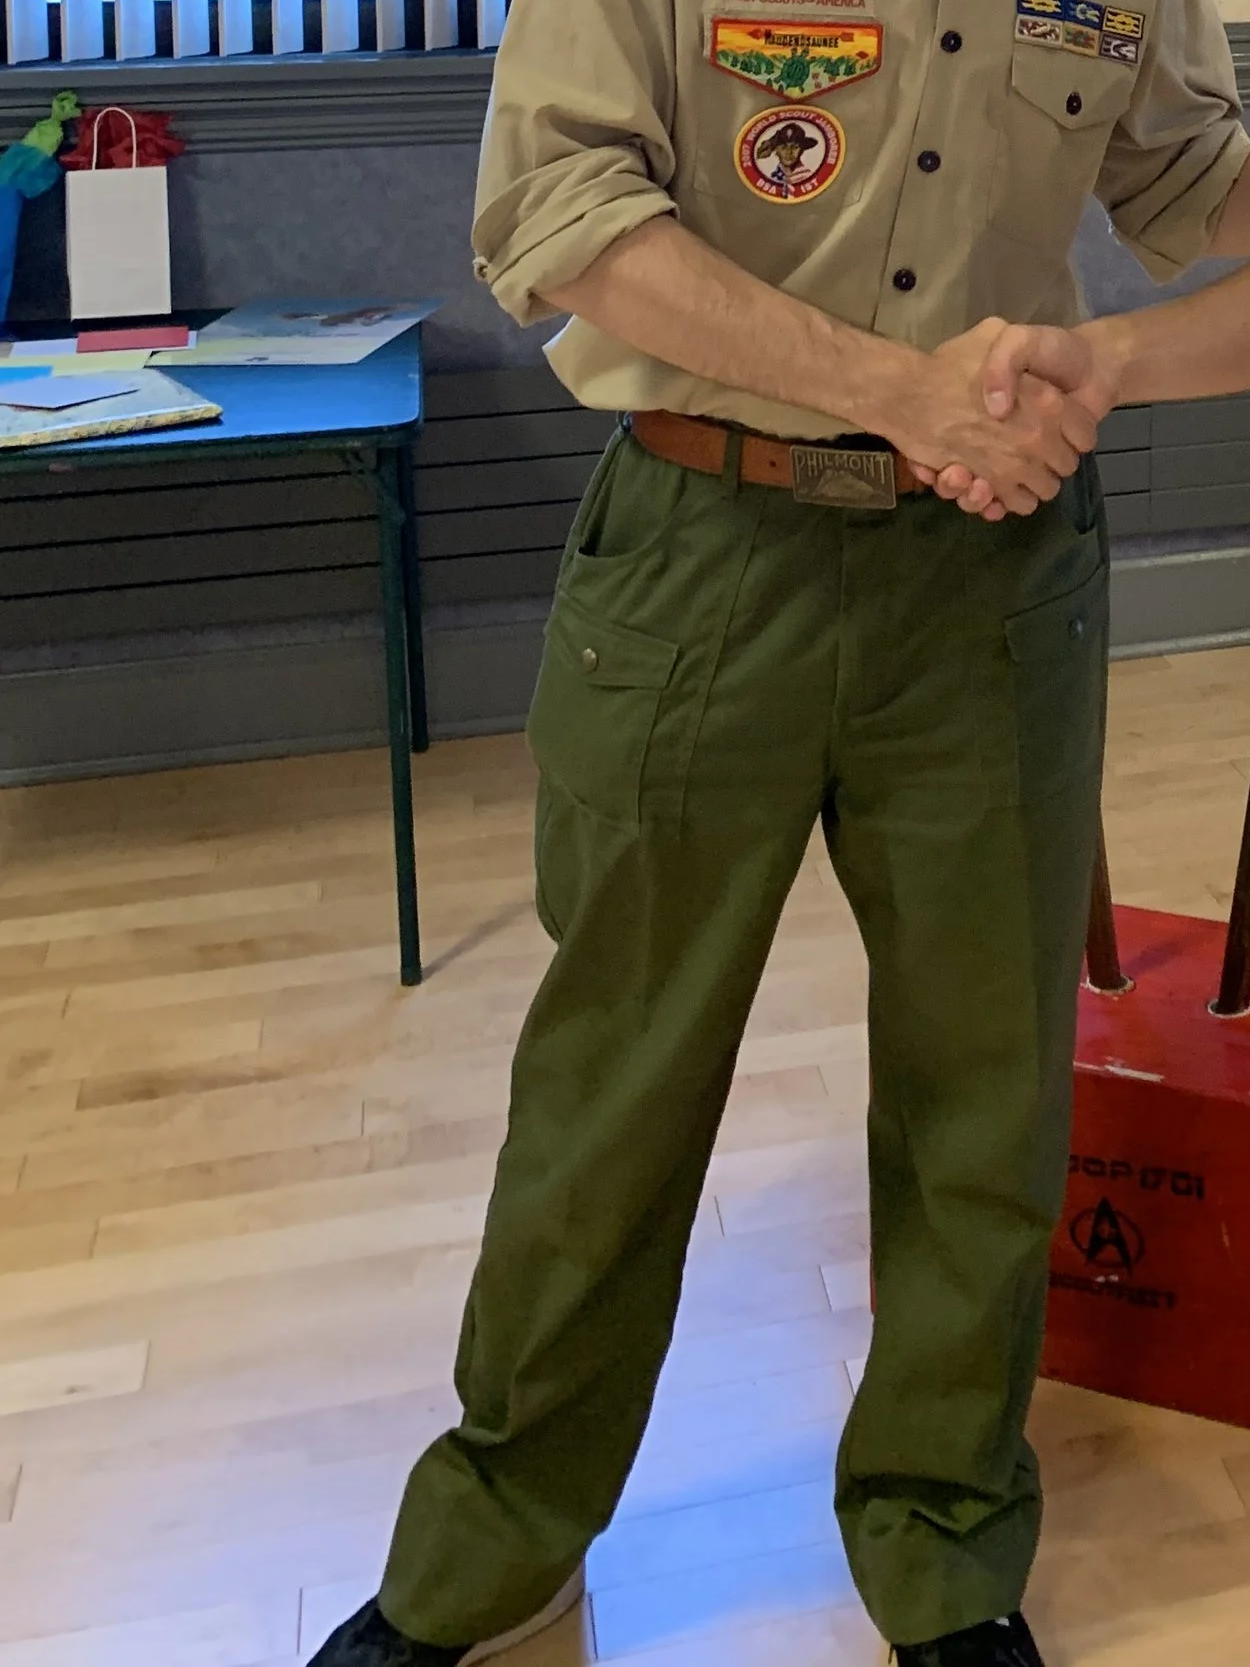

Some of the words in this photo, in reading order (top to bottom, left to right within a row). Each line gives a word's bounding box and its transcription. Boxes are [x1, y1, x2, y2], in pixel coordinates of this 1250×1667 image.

[742, 144, 752, 167] 2007
[747, 114, 777, 142] WORLD
[780, 111, 817, 119] SCOUT
[815, 118, 838, 165] JAMBOREE
[794, 451, 889, 484] PHILMONT
